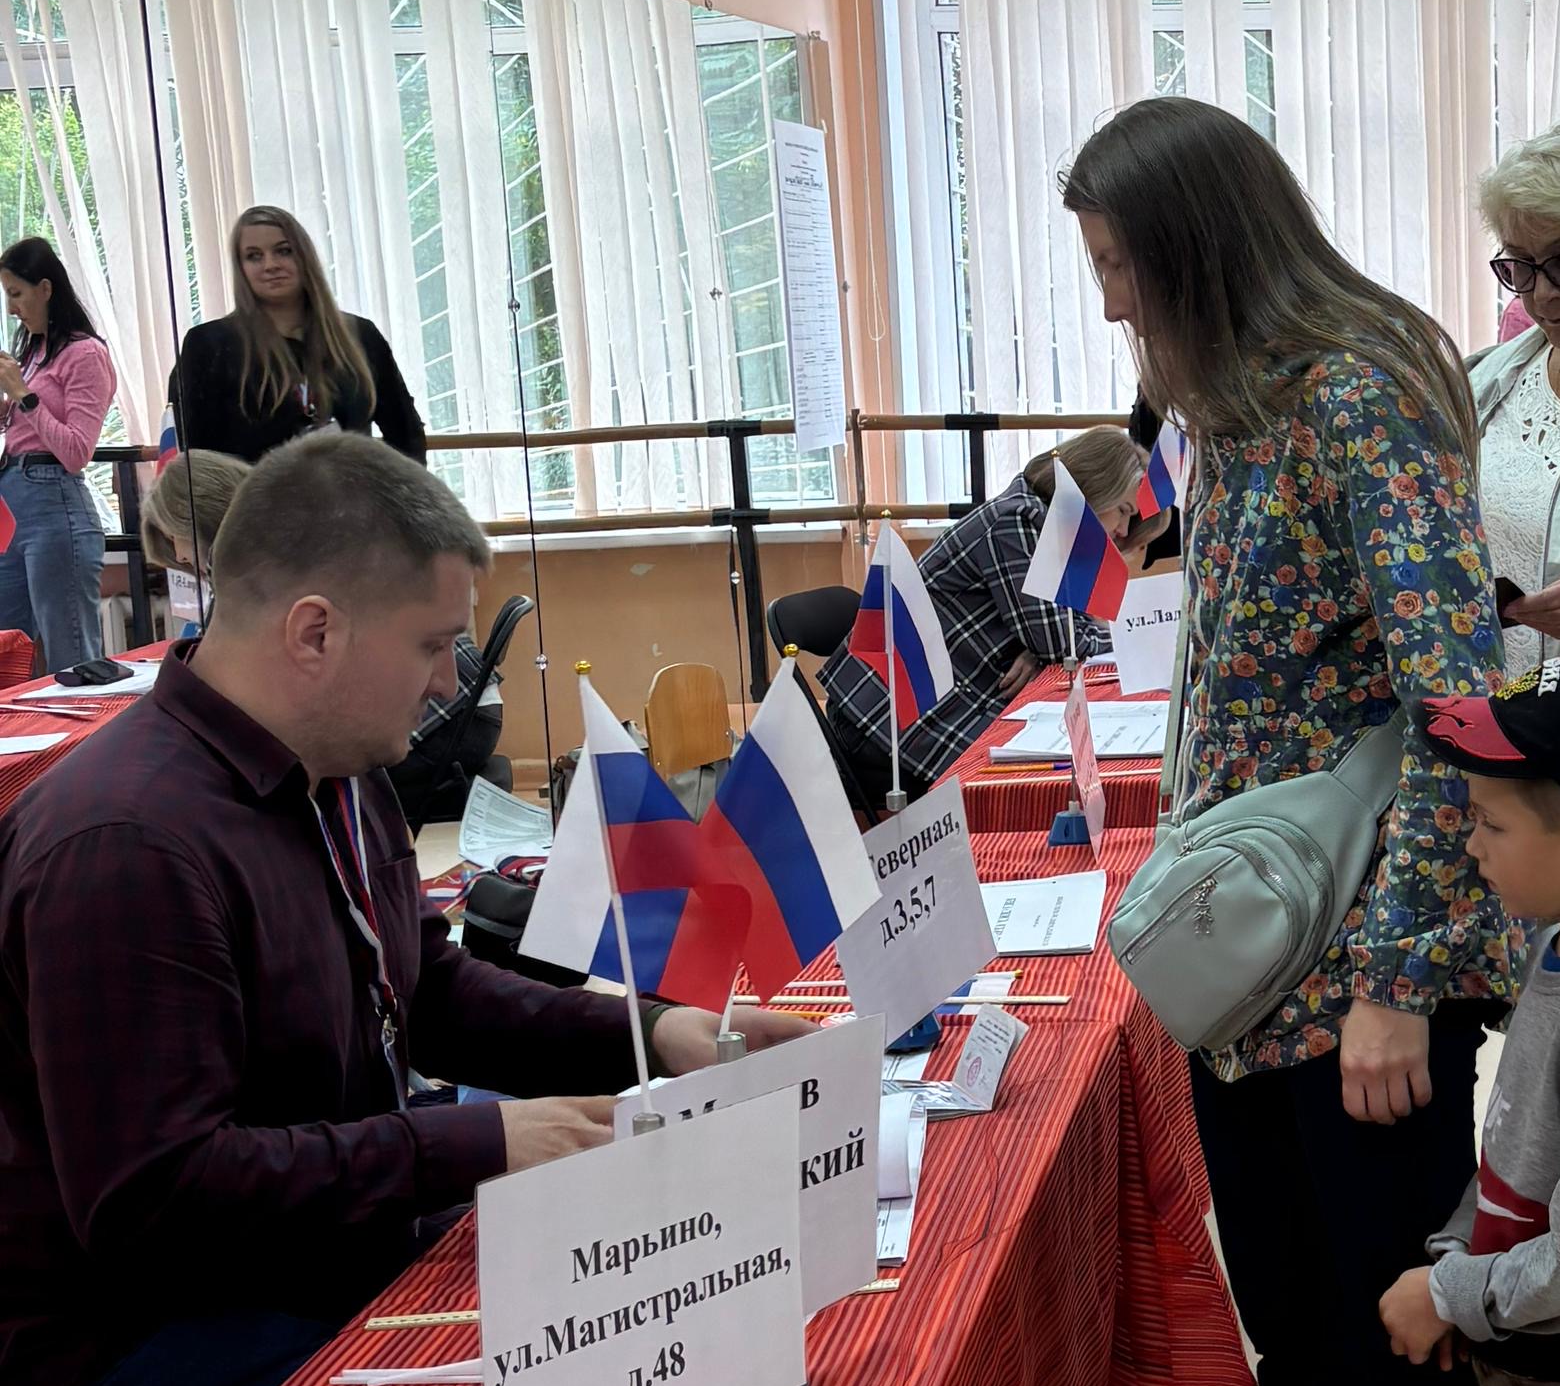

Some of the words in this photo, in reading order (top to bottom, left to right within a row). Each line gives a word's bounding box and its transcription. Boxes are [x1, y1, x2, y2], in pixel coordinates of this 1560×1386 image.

[1126, 609, 1181, 632] ул.Лад
[869, 812, 960, 880] еверная,
[880, 875, 936, 948] д.3,5,7
[571, 1210, 723, 1284] Марьино,
